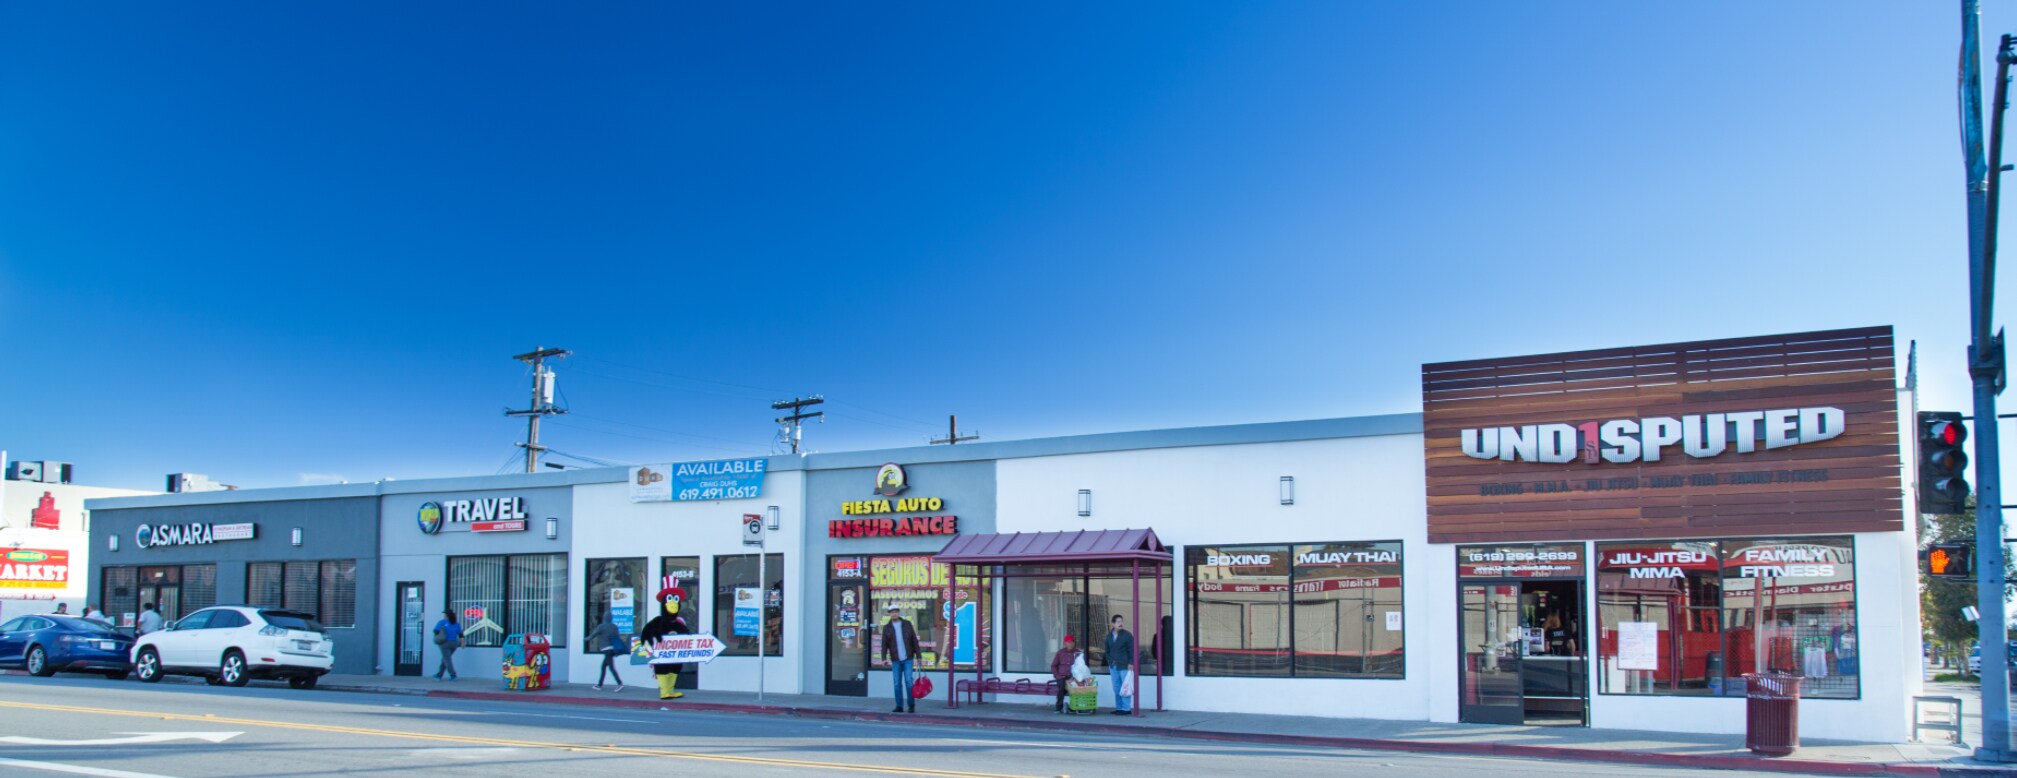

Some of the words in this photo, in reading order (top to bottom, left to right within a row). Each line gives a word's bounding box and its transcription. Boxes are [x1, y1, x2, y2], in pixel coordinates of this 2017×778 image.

[677, 459, 763, 476] AVAILABLE
[679, 485, 758, 500] 619.491.0612
[443, 496, 525, 522] TRAVEL
[842, 499, 892, 515] FIESTA
[896, 497, 942, 513] AUTO
[149, 522, 213, 546] ASMARA
[829, 515, 955, 539] INSURANCE
[1207, 554, 1271, 566] BOXING
[1300, 552, 1351, 564] MUAY
[1353, 551, 1397, 563] THAI
[1469, 553, 1505, 562] (619)
[1609, 550, 1707, 565] JIU-JITSU
[1745, 549, 1827, 562] FAMILY
[0, 563, 67, 581] ARKET
[871, 557, 929, 587] SEGUROS
[931, 562, 950, 586] DE
[1630, 566, 1686, 579] MMA
[1740, 564, 1835, 578] FITNESS
[943, 589, 968, 600] Dsde
[654, 639, 693, 651] INCOME
[696, 638, 714, 649] TAX
[658, 650, 676, 659] FAST
[677, 649, 714, 659] REFUNDS!
